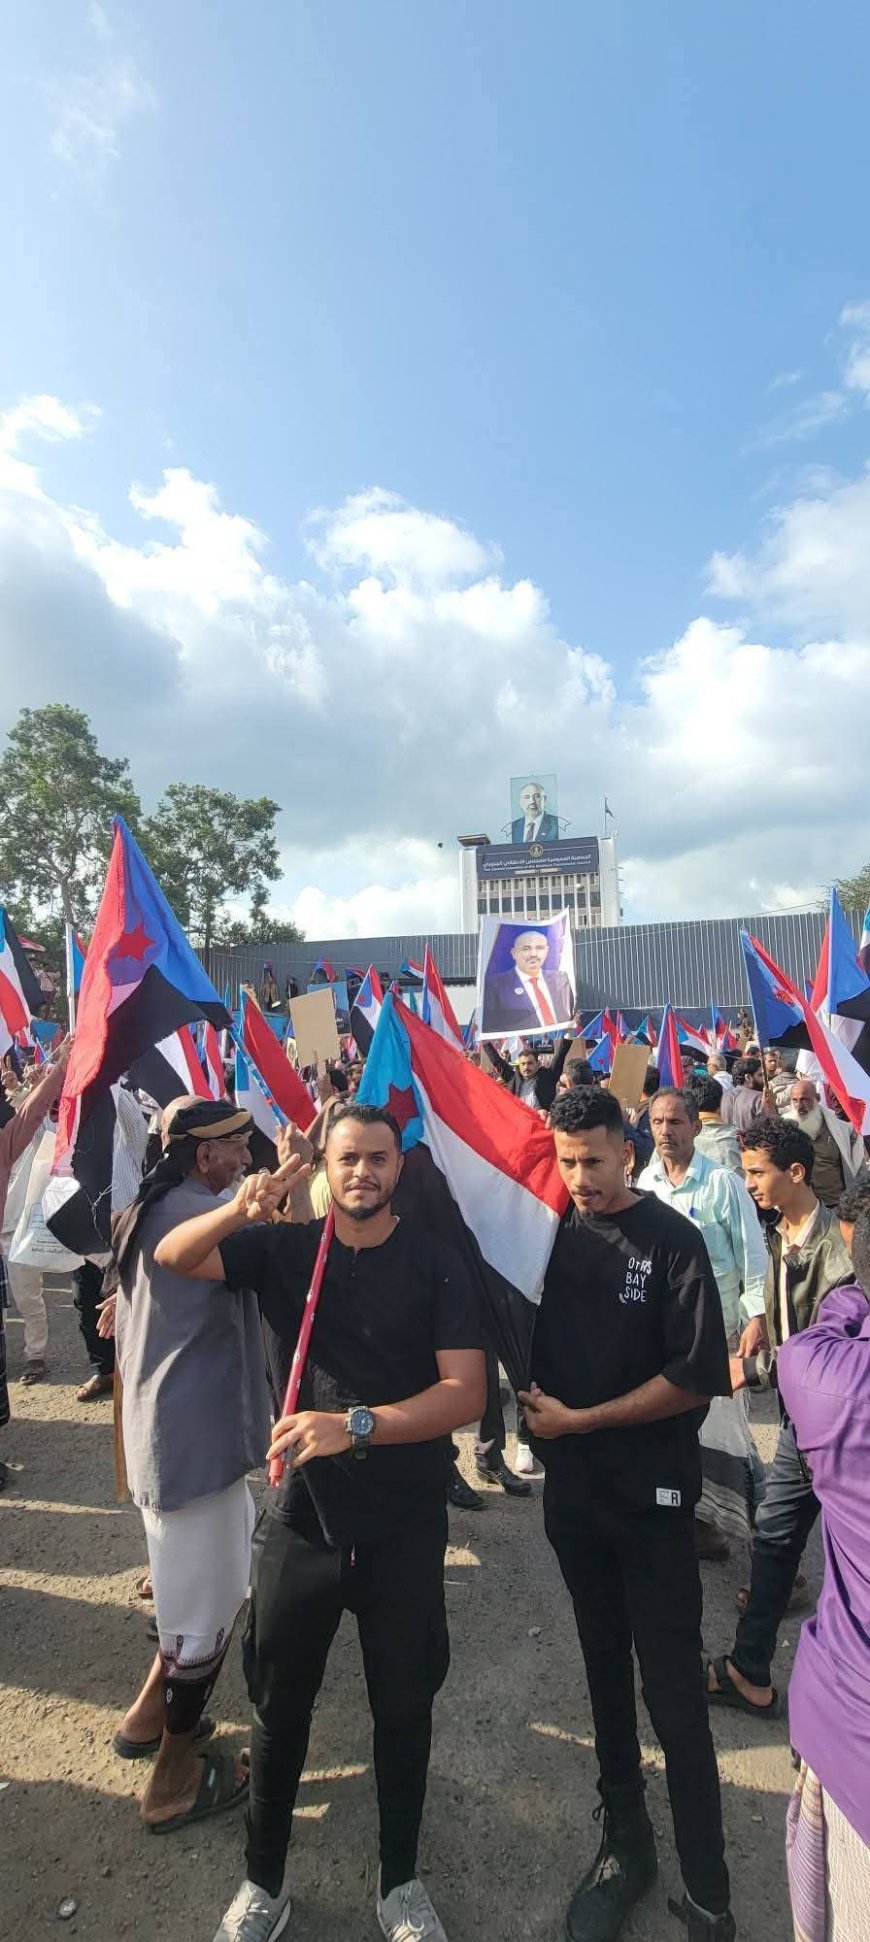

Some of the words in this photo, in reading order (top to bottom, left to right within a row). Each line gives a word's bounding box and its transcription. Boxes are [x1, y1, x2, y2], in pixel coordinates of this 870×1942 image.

[626, 1271, 646, 1288] BAY
[624, 1285, 647, 1302] SIDE
[671, 1491, 679, 1505] R
